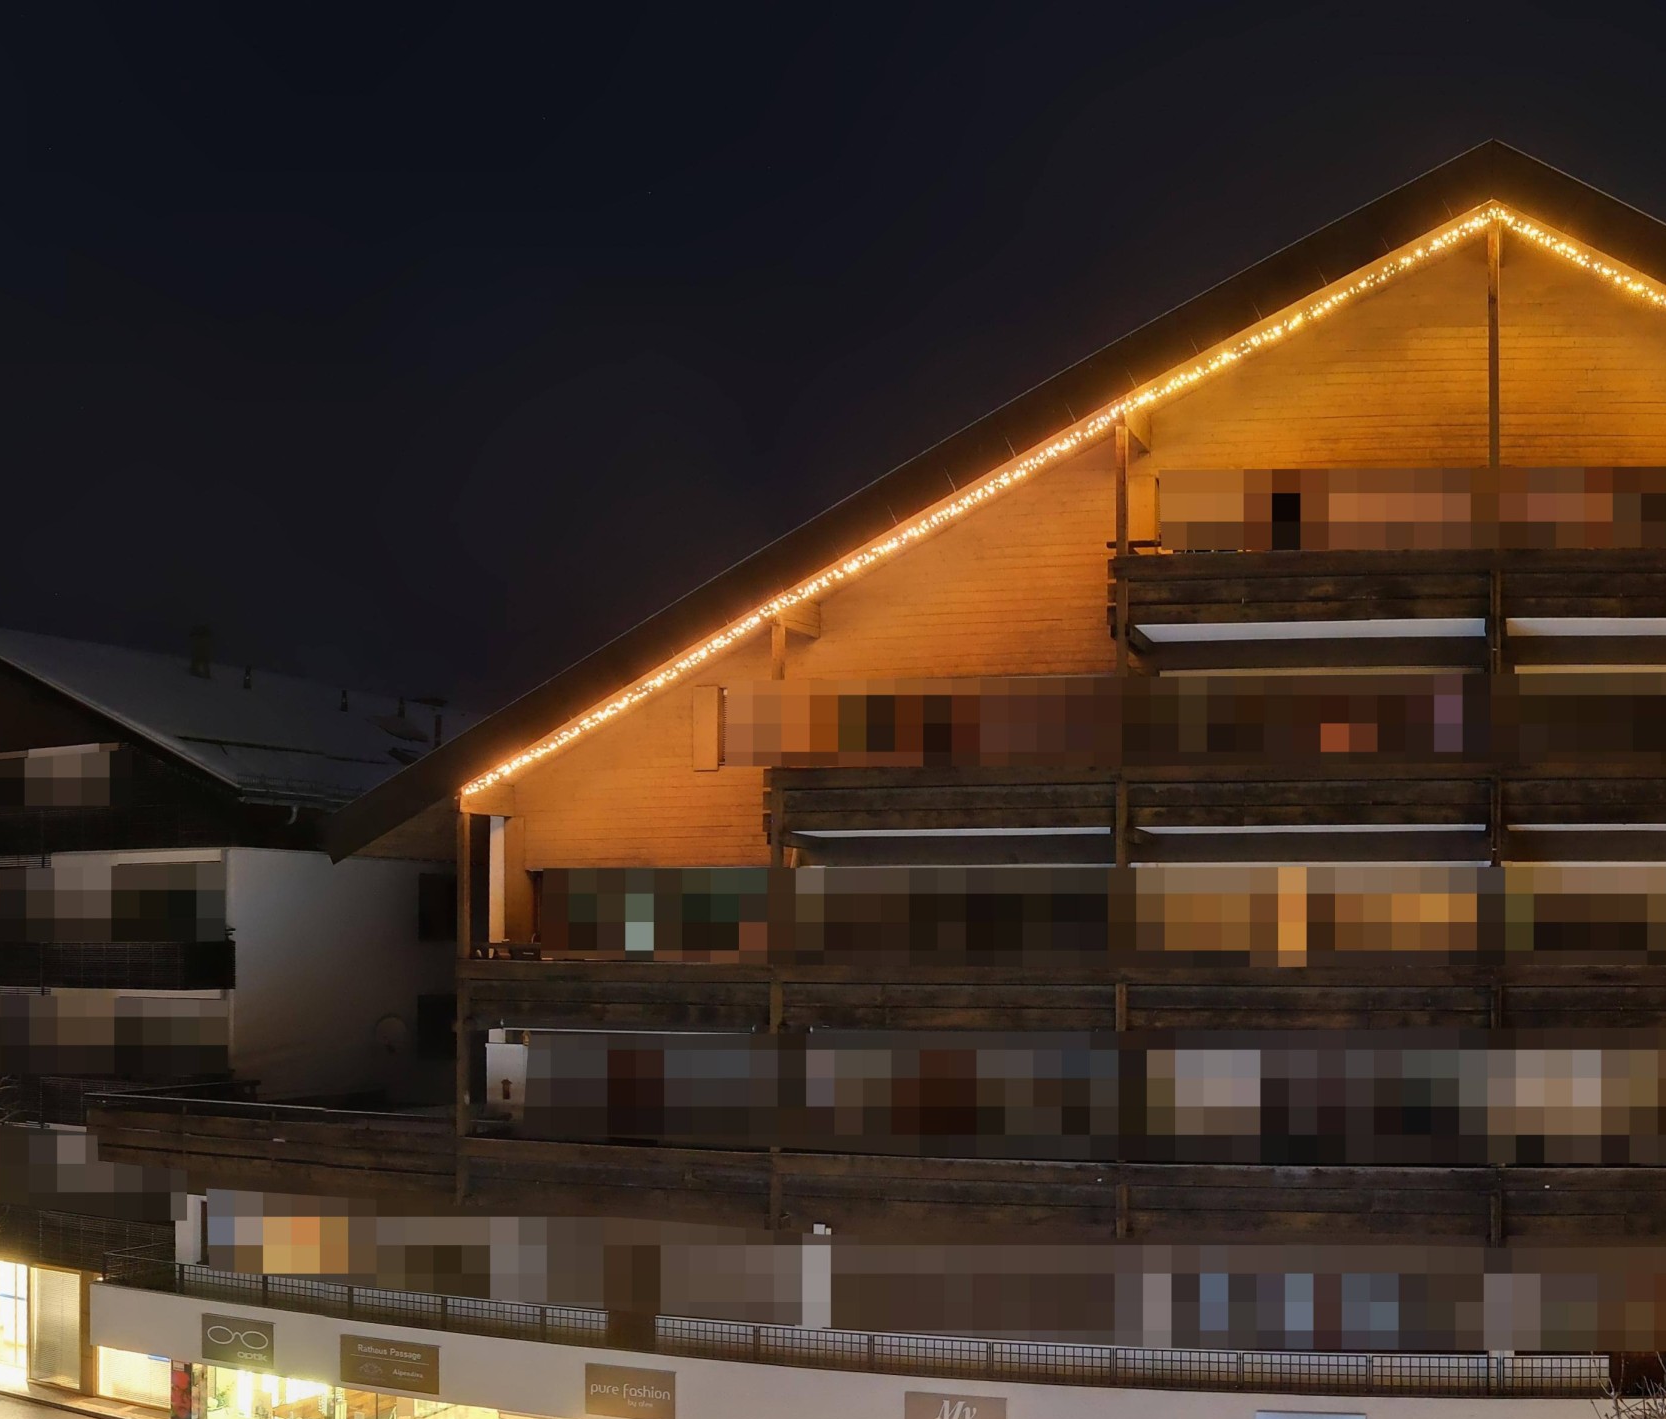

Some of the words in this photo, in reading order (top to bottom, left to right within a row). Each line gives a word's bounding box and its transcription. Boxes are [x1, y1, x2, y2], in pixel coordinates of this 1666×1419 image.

[237, 1350, 268, 1362] optik
[357, 1343, 387, 1356] Rathaus
[389, 1347, 422, 1361] Passage
[590, 1383, 619, 1395] pure
[623, 1383, 671, 1400] fashion
